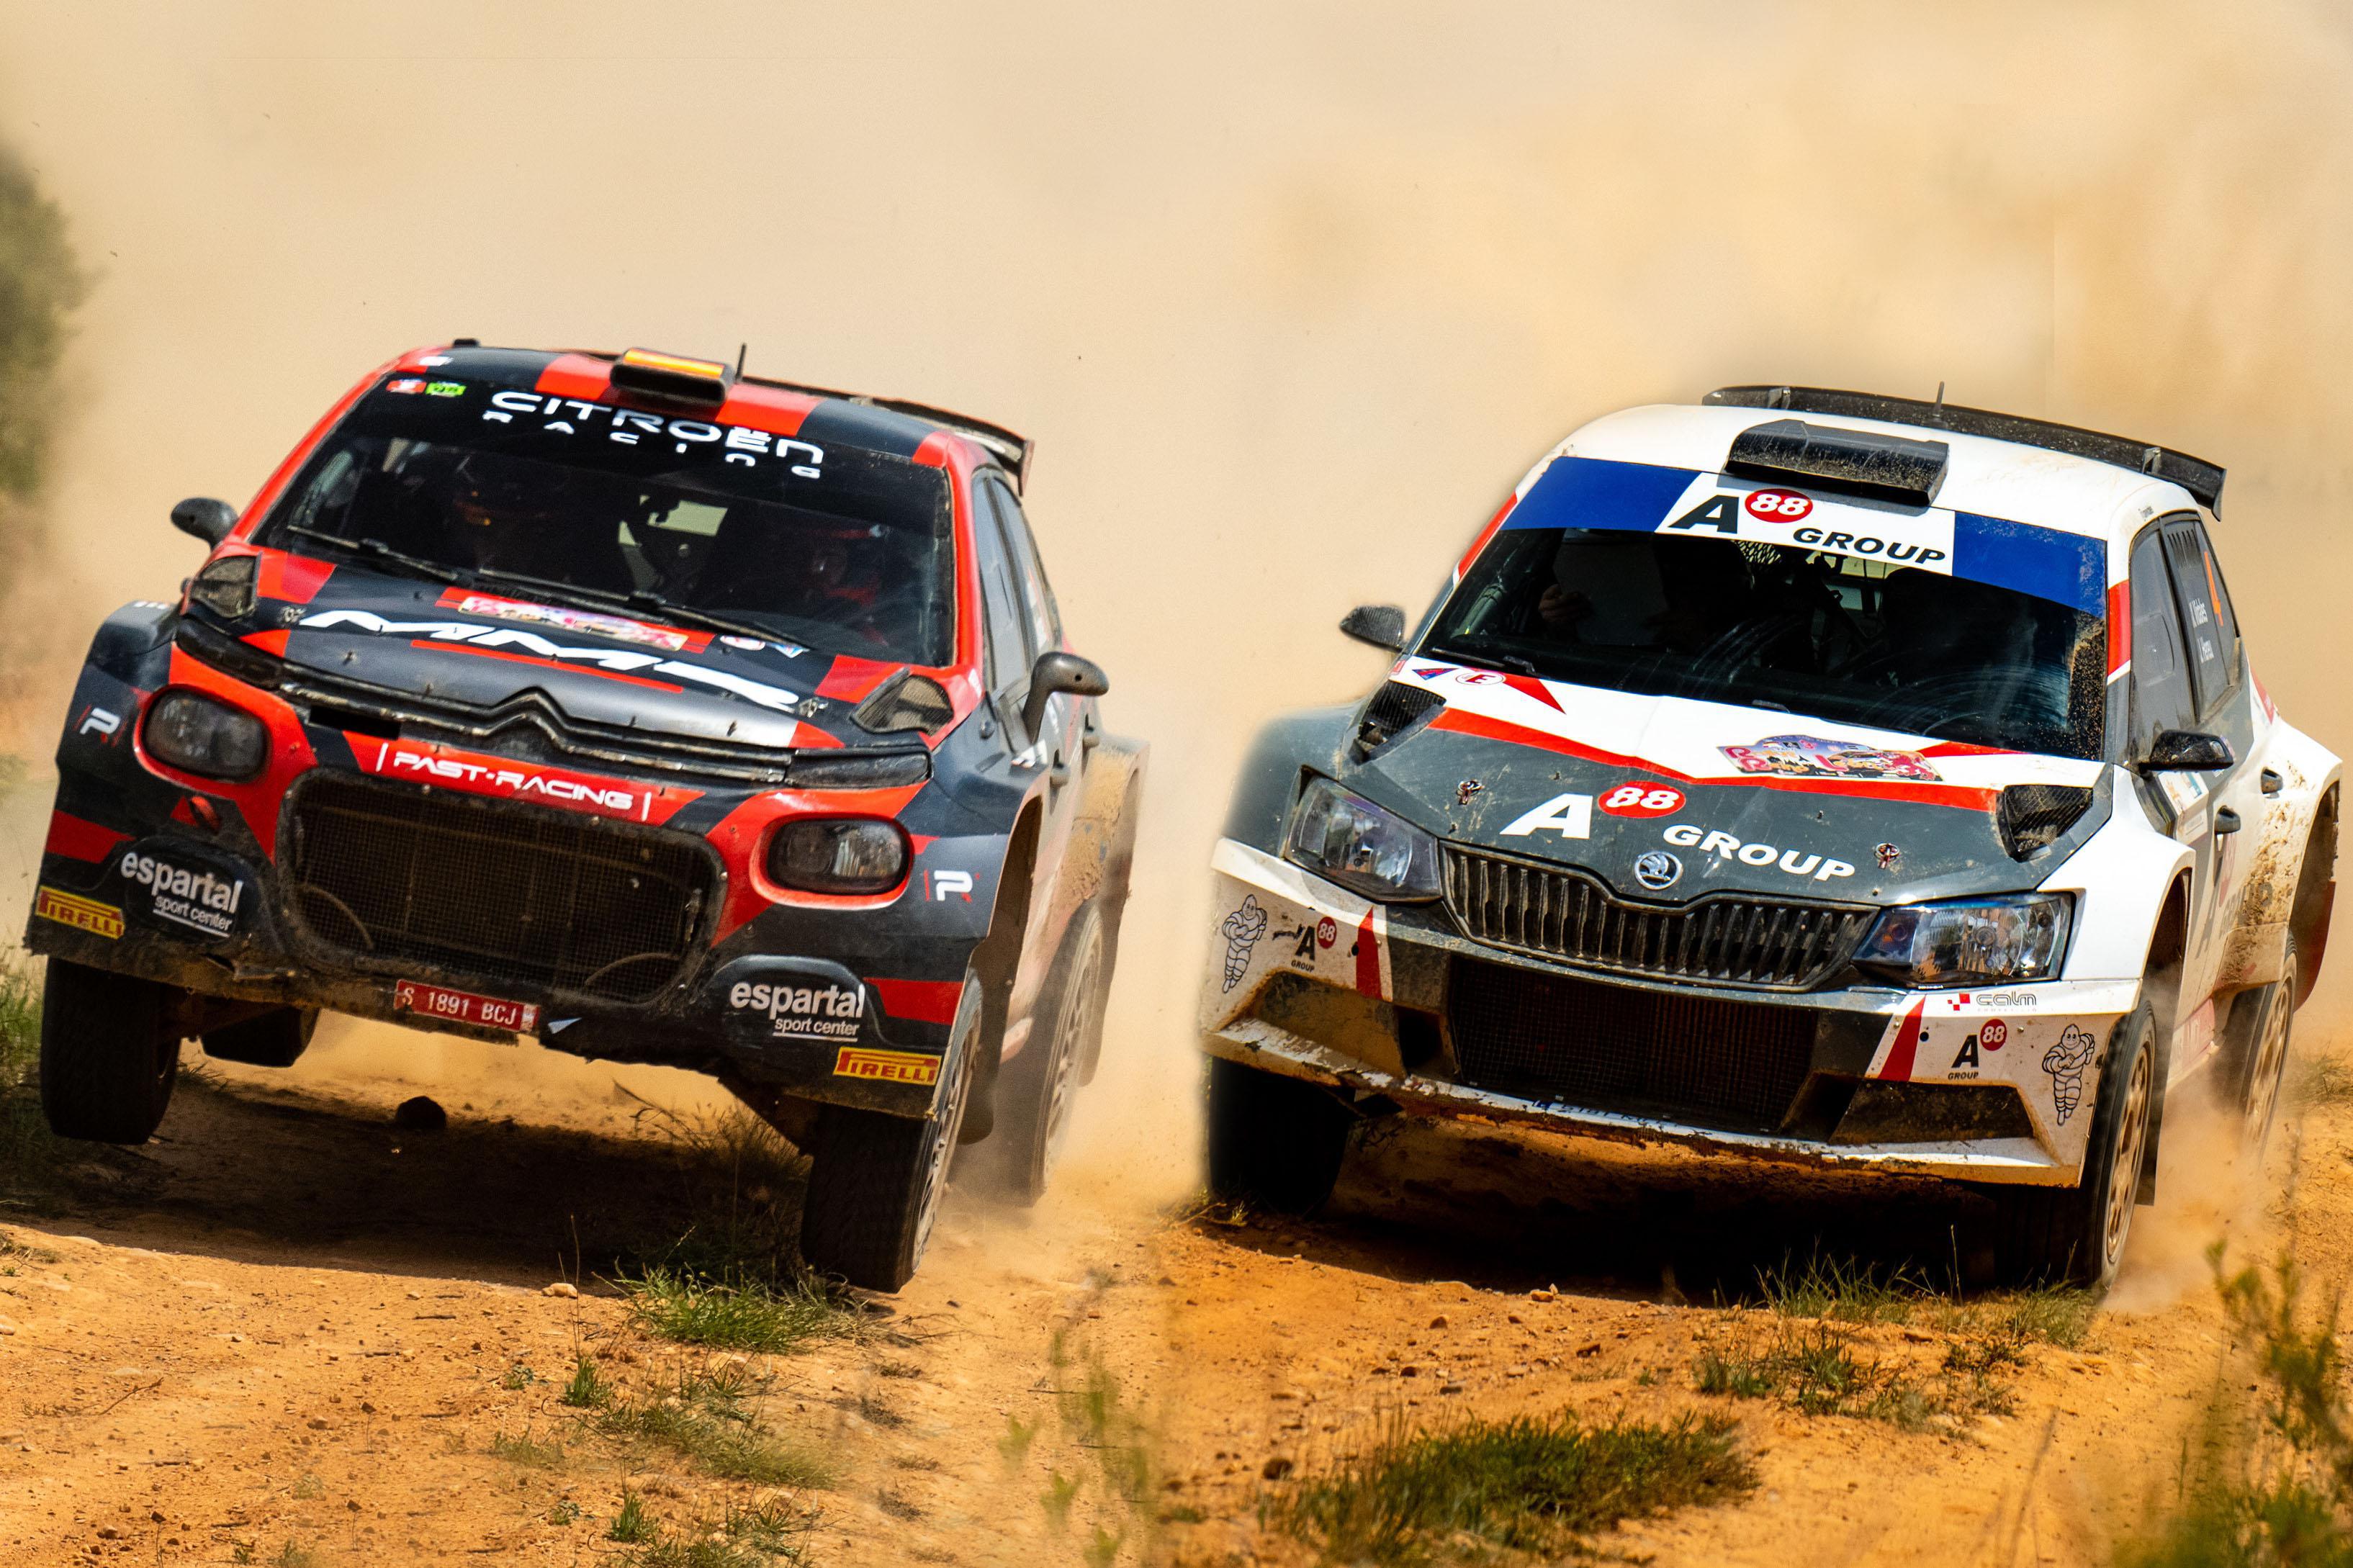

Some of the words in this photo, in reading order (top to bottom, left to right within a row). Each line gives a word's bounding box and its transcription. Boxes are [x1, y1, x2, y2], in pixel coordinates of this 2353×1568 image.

[1668, 495, 1739, 534] A
[1750, 493, 1809, 516] 88
[1793, 527, 1945, 564] GROUP
[1499, 793, 1593, 839] A
[1606, 786, 1679, 810] 88
[1663, 824, 1855, 881] GROUP
[120, 852, 243, 914] espartal
[37, 888, 123, 937] PIRELLI
[155, 896, 190, 919] sport
[189, 907, 233, 931] center
[1295, 926, 1315, 960] A
[1318, 922, 1336, 942] 88
[1291, 960, 1315, 972] GROUP
[402, 987, 415, 1006] S
[428, 991, 470, 1017] 1891
[481, 1002, 516, 1026] BCJ
[730, 982, 865, 1019] espartal
[1976, 991, 2037, 1006] calm
[775, 1017, 811, 1034] sport
[814, 1019, 860, 1037] center
[1951, 1035, 1979, 1068] A
[1982, 1025, 2005, 1043] 88
[836, 1050, 939, 1083] PIRELLI
[1948, 1071, 1979, 1080] GROUP
